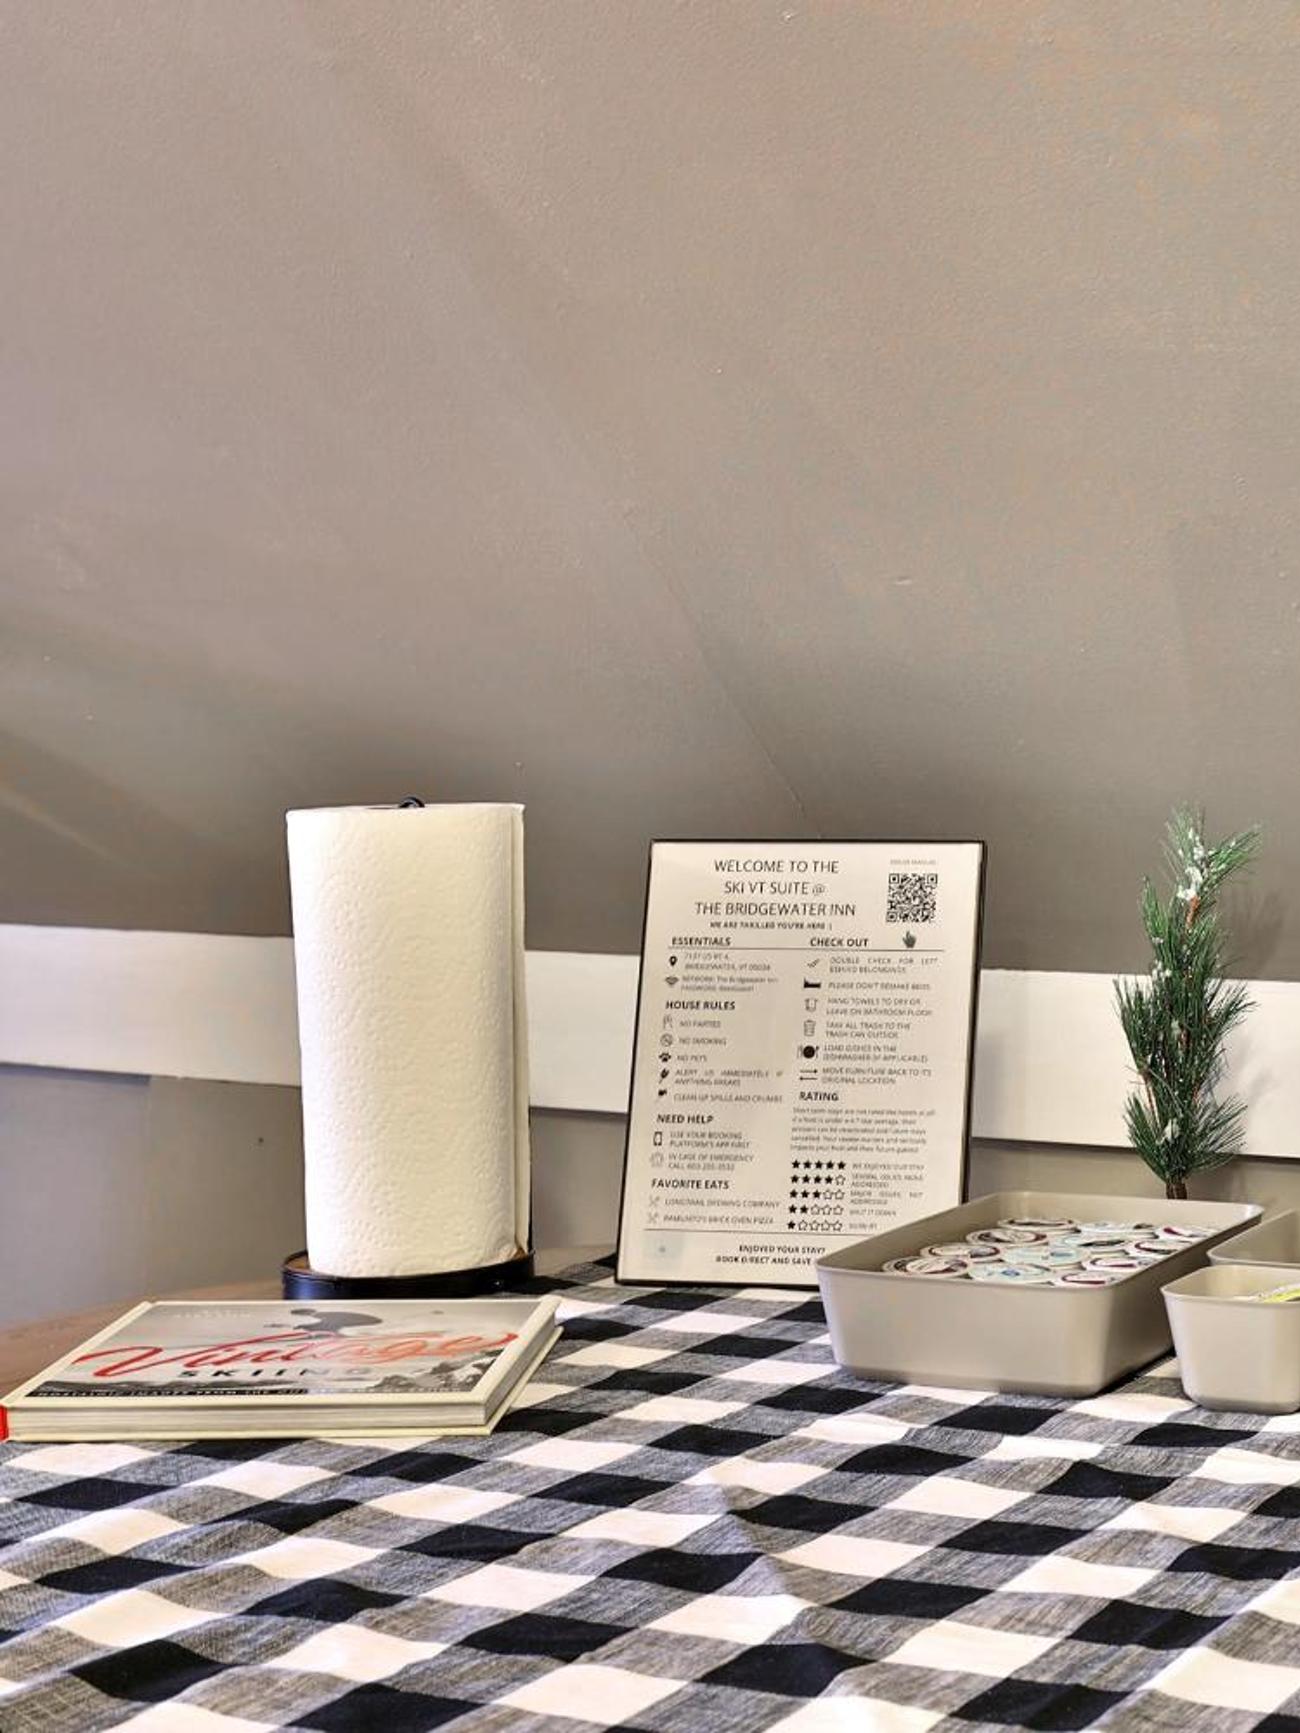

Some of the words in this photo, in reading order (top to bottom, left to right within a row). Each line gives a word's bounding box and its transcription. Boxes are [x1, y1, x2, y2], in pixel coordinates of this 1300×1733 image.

[714, 860, 785, 873] WELCOME
[789, 860, 808, 873] TO
[813, 860, 839, 874] THE
[724, 881, 745, 894] SKI
[749, 882, 766, 895] VT
[769, 882, 809, 896] SUITE
[811, 883, 826, 896] @
[694, 902, 722, 915] THE
[724, 902, 827, 917] BRIDGEWATER
[829, 904, 856, 917] INN
[777, 922, 804, 930] YOU'RE
[806, 922, 825, 930] HERE
[671, 936, 732, 946] ESSENTIALS
[810, 938, 844, 947] CHECK
[846, 938, 869, 947] OUT
[867, 957, 891, 965] CHECK
[899, 957, 914, 965] FOR
[665, 1001, 700, 1010] HOUSE
[703, 1001, 736, 1010] RULES
[909, 998, 921, 1006] OR
[679, 1020, 691, 1028] NO
[884, 1022, 895, 1030] TO
[679, 1037, 690, 1045] NO
[676, 1054, 689, 1062] NO
[690, 1054, 708, 1062] PETS
[888, 1068, 907, 1076] BACK
[909, 1068, 920, 1076] TO
[799, 1092, 839, 1101] RATING
[656, 1114, 685, 1124] NEED
[687, 1114, 714, 1124] HELP
[651, 1178, 702, 1189] FAVORITE
[704, 1179, 730, 1190] EATS
[739, 1244, 776, 1253] ENJOYED
[777, 1245, 800, 1254] YOUR
[801, 1246, 826, 1254] STAY?
[715, 1255, 739, 1263] BOOK
[770, 1256, 790, 1264] AND
[70, 1331, 518, 1377] Vintage
[176, 1367, 371, 1378] SKIING
